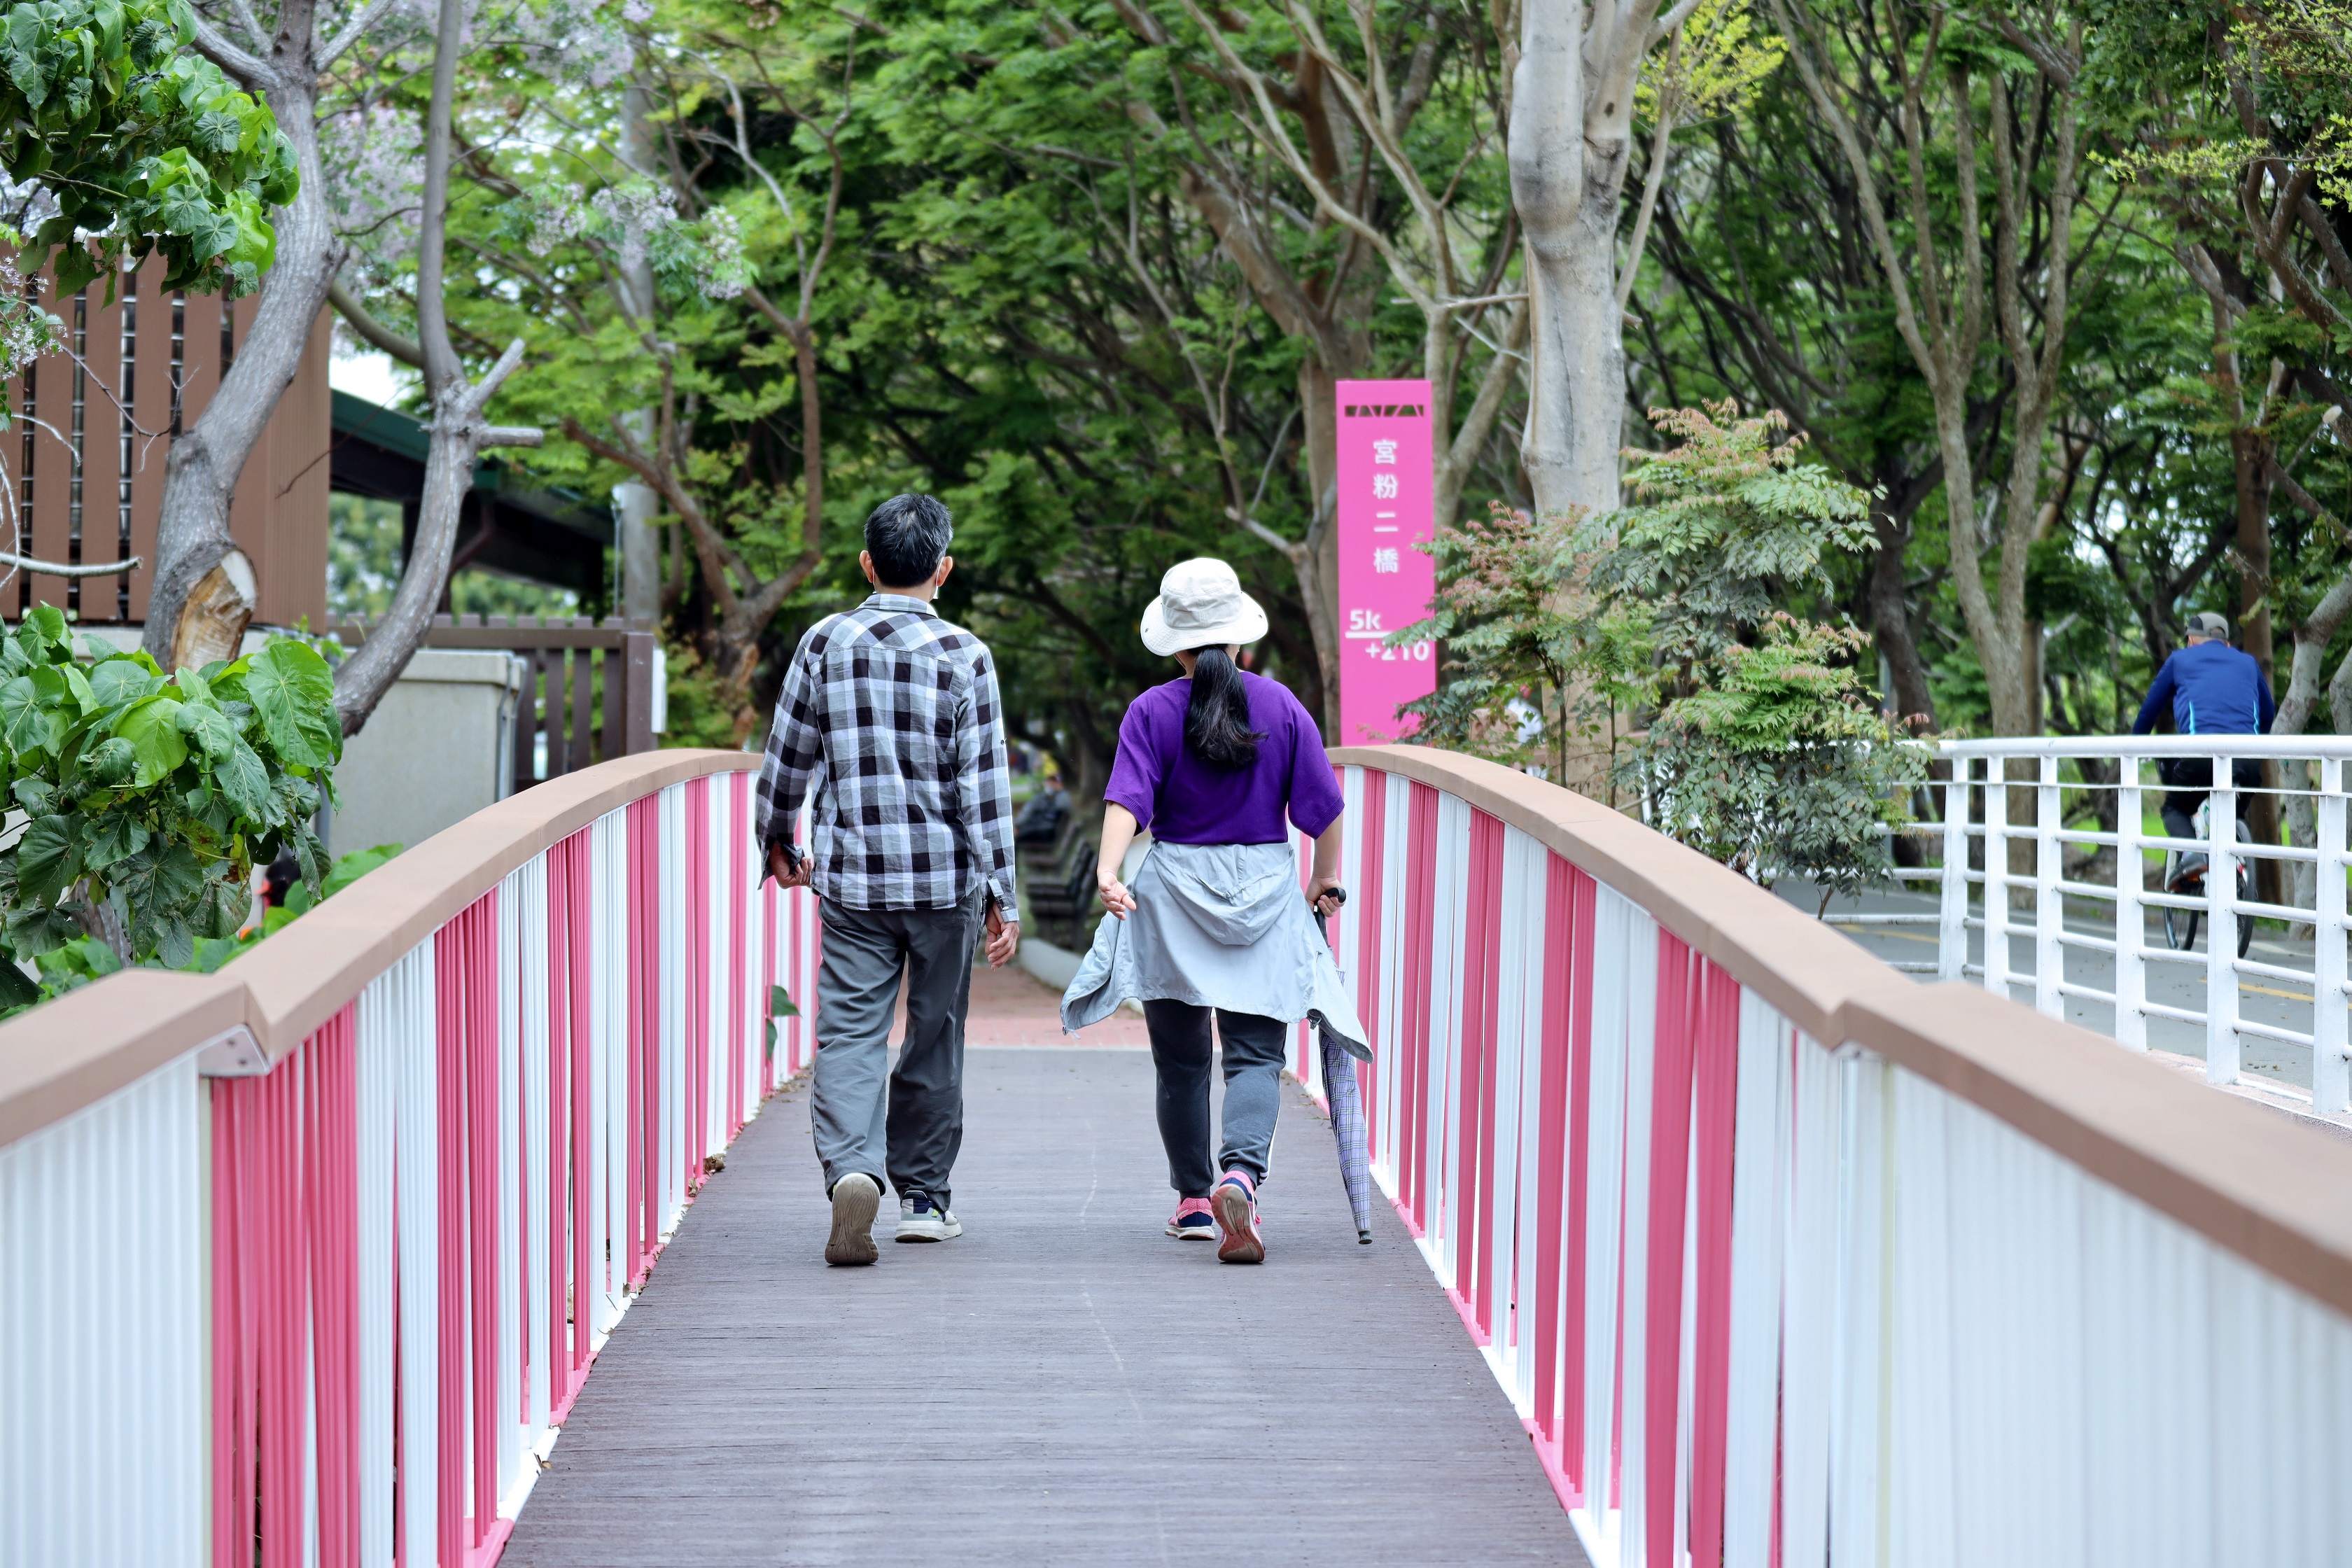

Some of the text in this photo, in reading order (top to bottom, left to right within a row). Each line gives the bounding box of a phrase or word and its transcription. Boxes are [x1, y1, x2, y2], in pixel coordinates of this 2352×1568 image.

[1373, 439, 1399, 573] 宮粉二橋
[1349, 609, 1381, 631] 5k
